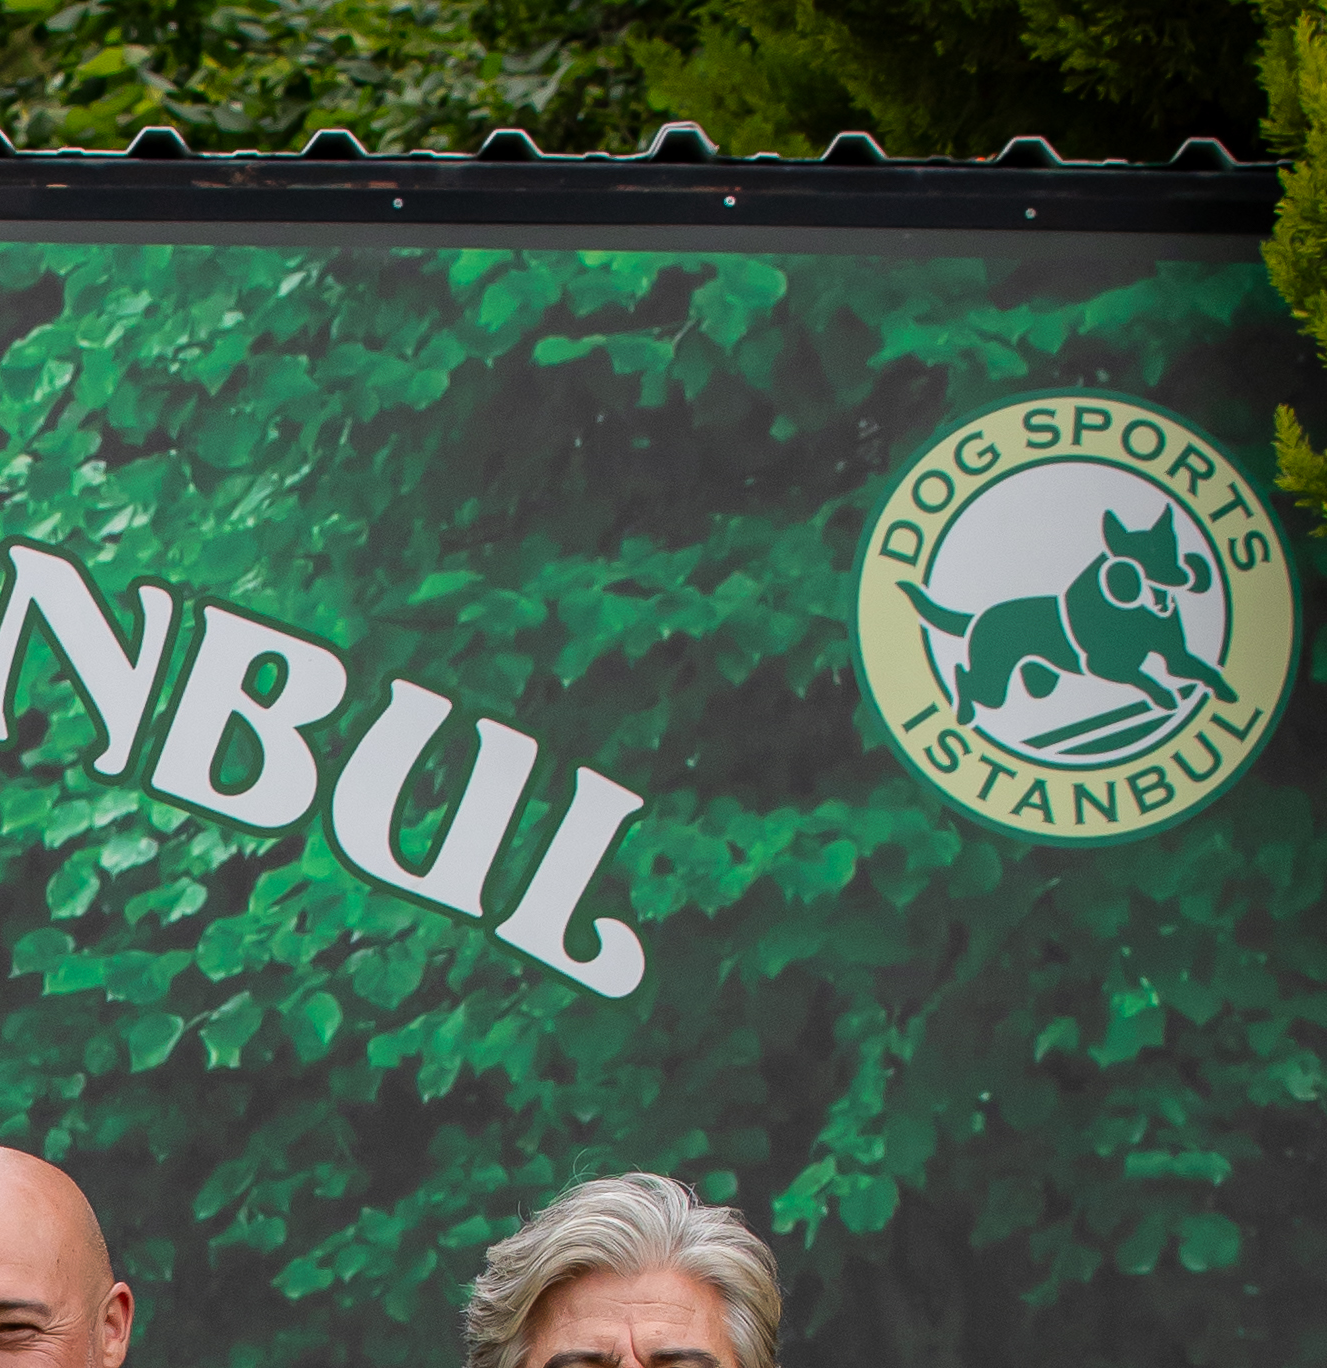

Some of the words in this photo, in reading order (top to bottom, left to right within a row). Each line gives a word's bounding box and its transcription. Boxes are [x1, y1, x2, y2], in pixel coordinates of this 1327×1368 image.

[879, 430, 1001, 567] DOG
[1022, 404, 1271, 572] SPORTS
[901, 701, 1264, 826] ISTANBUL
